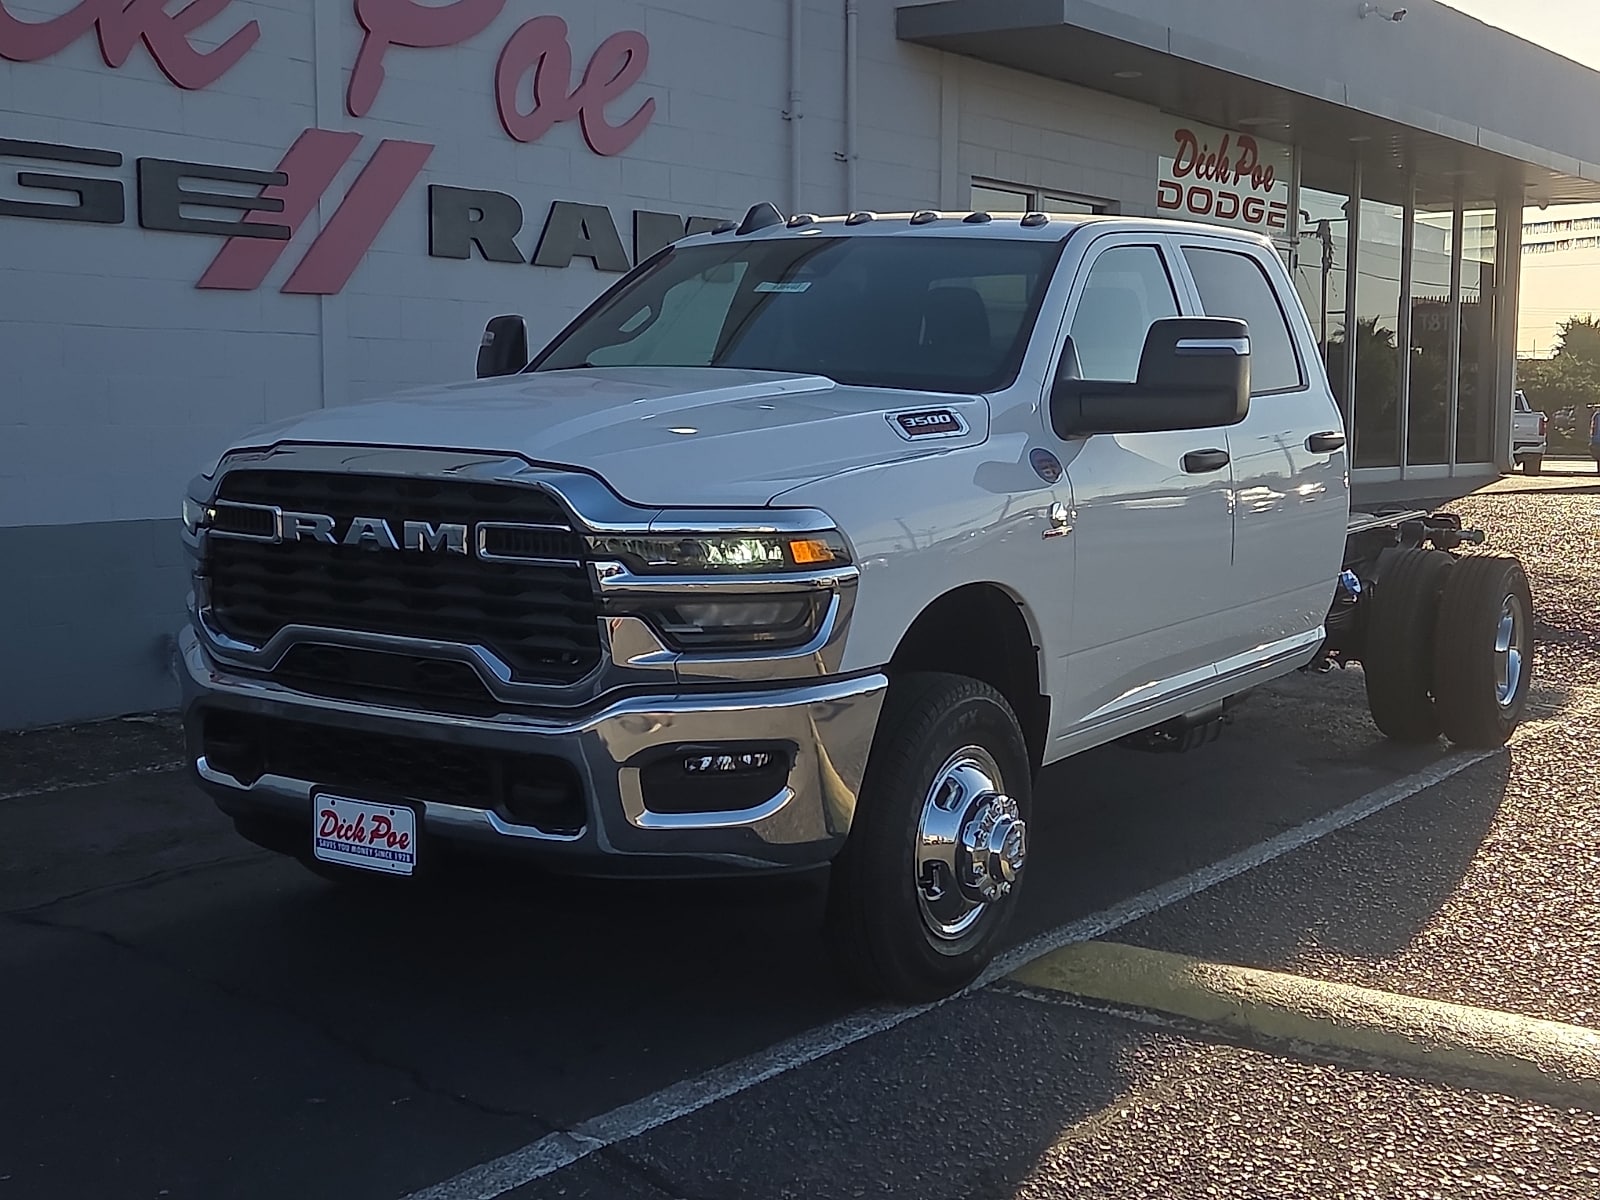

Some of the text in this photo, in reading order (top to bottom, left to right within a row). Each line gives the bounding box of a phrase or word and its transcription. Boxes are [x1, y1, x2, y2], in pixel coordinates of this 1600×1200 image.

[1173, 128, 1274, 192] Dick Poe
[1157, 179, 1288, 228] DODGE
[903, 414, 952, 428] 3500
[282, 510, 469, 555] RAM
[319, 839, 337, 850] SAVES
[338, 843, 350, 852] YOU
[351, 846, 373, 856] MONEY
[374, 849, 393, 860] SINCE
[320, 809, 410, 850] Dick Poe
